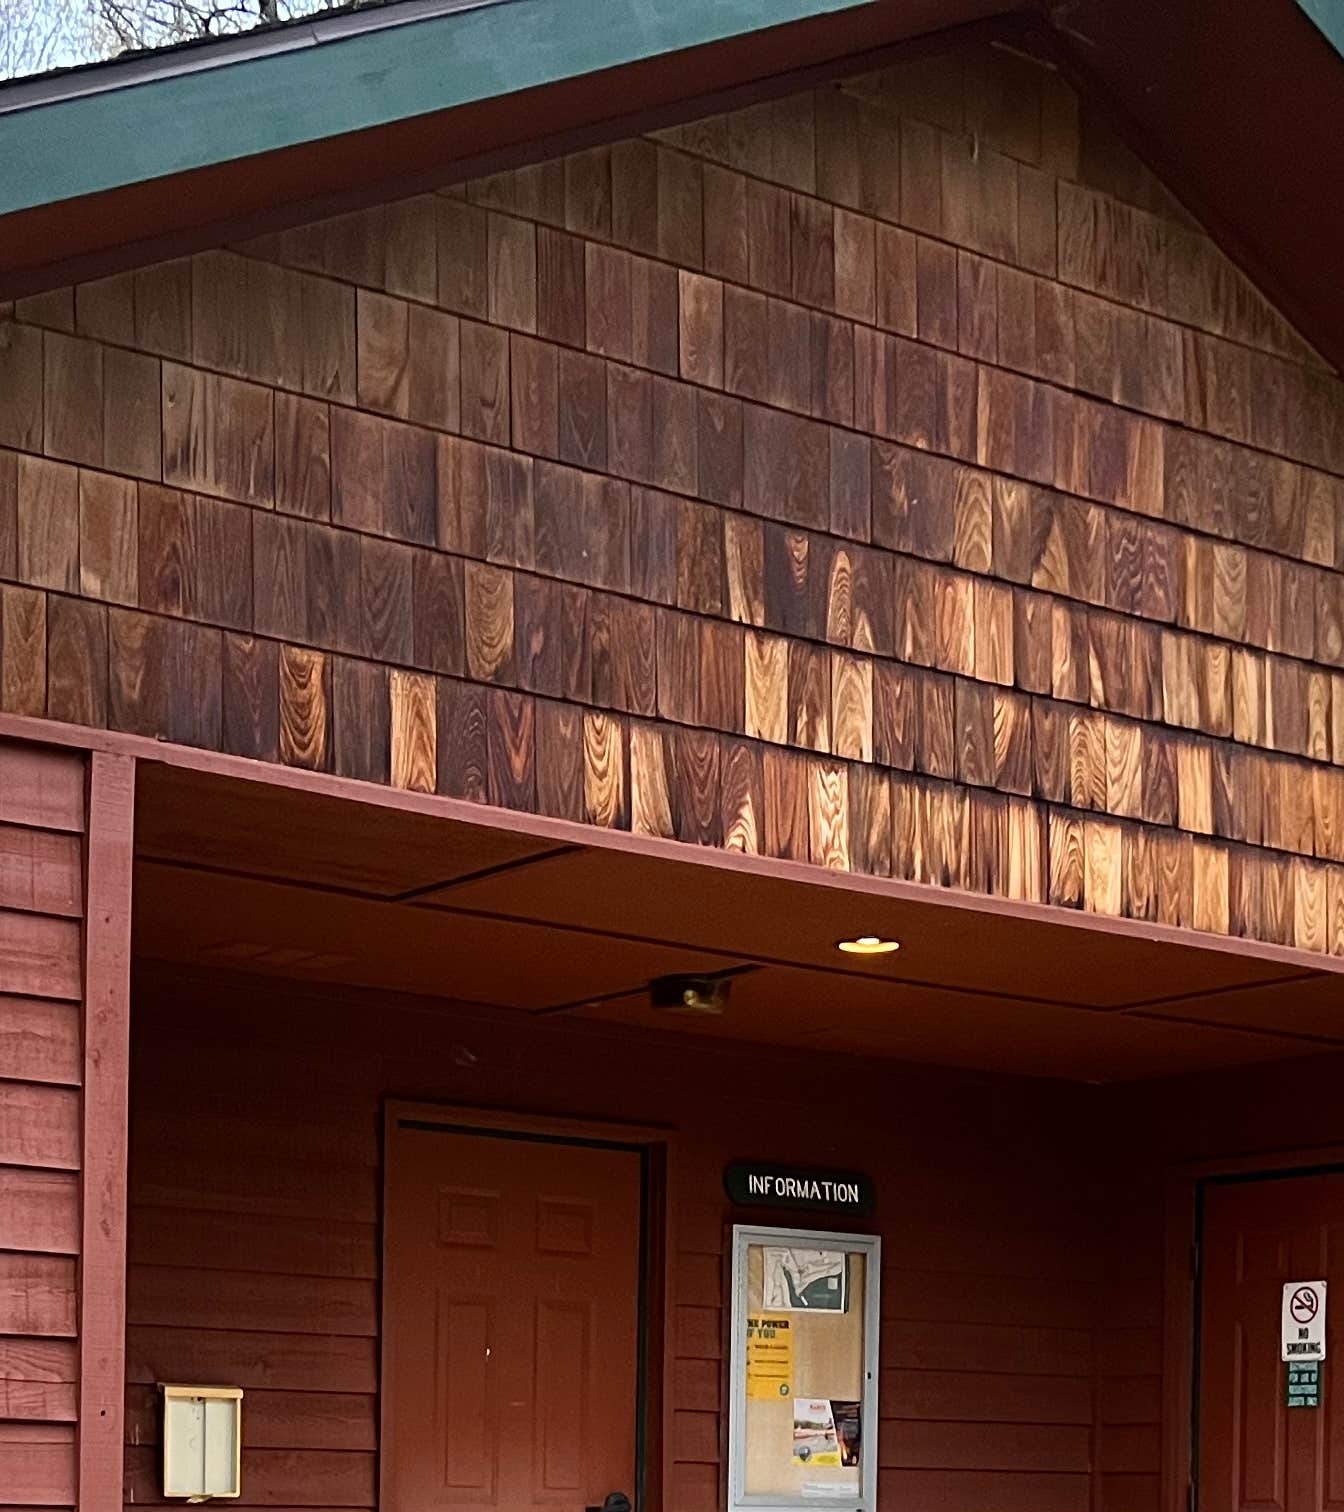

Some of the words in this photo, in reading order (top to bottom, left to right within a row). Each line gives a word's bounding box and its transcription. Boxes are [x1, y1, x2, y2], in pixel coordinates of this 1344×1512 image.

[748, 1173, 859, 1203] INFORMATION
[762, 1320, 790, 1329] POWER
[758, 1328, 776, 1339] YOU
[1298, 1327, 1309, 1340] NO
[1286, 1341, 1322, 1356] SMOKING
